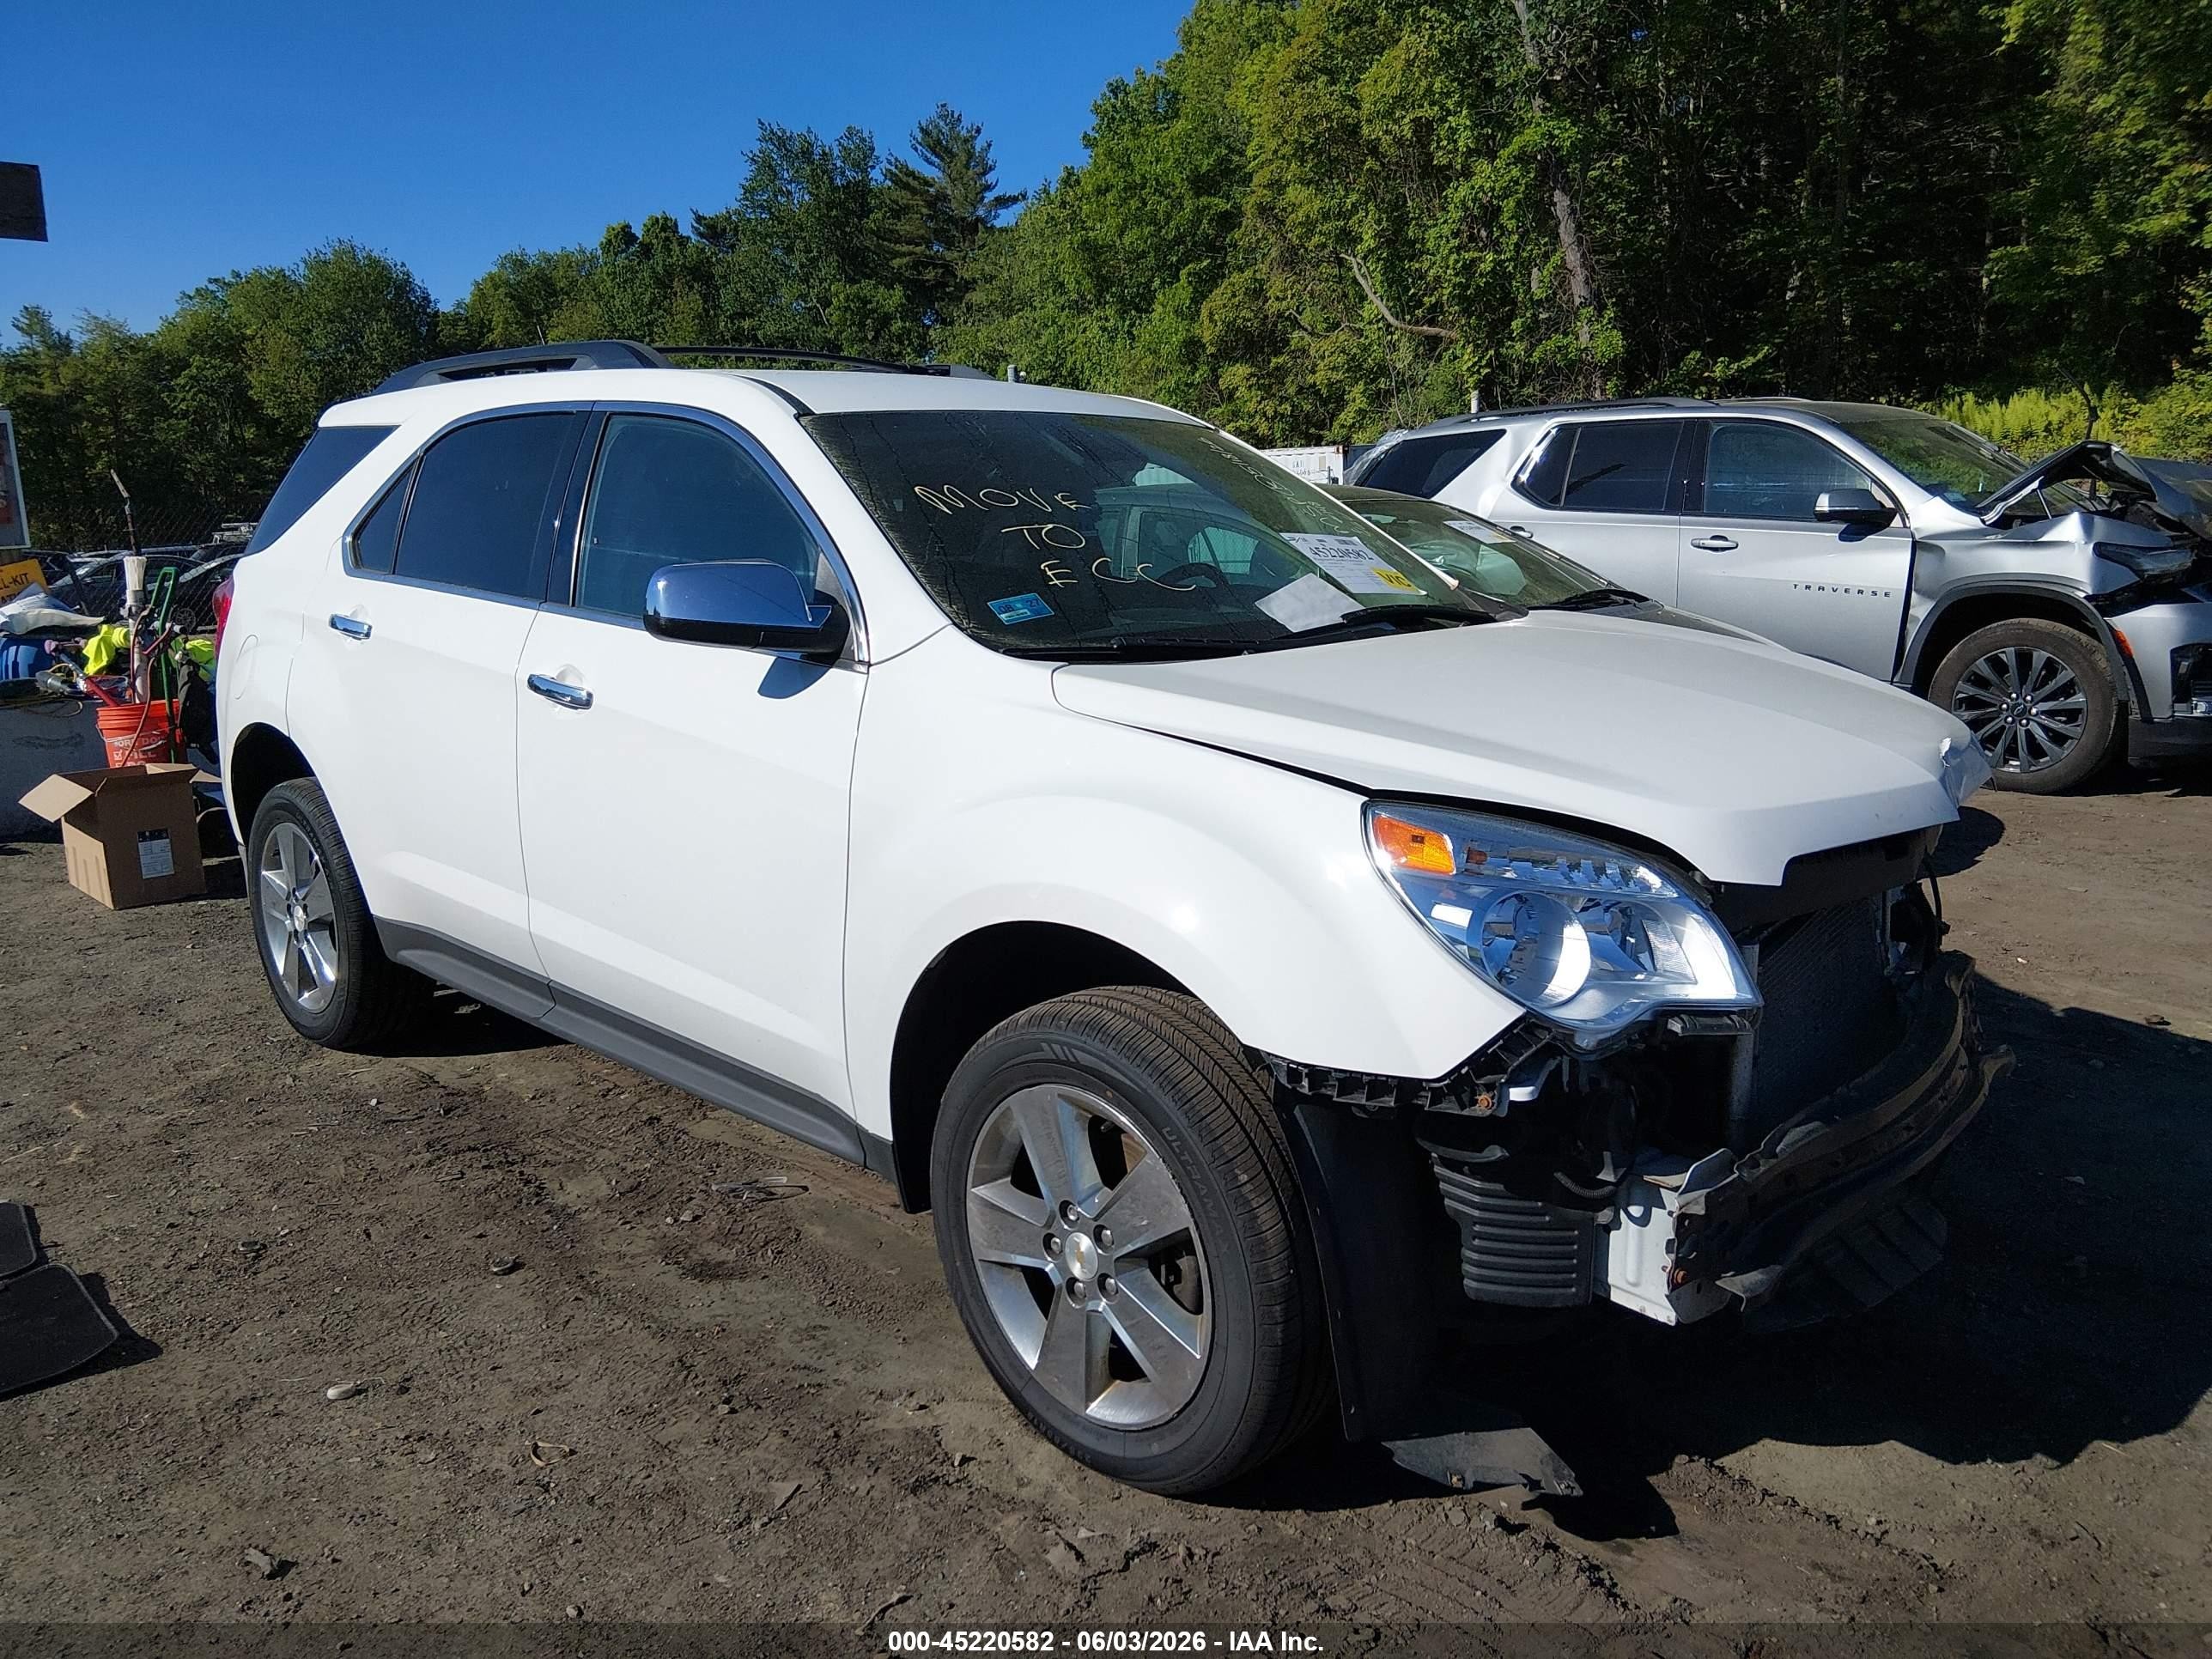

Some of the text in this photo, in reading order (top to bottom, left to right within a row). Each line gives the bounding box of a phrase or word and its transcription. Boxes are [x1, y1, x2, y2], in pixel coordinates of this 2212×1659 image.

[914, 484, 1091, 514] MOVE
[1000, 523, 1085, 550] TO
[1040, 557, 1196, 591] ECC
[1376, 571, 1413, 588] VIC
[1792, 583, 1892, 599] TRAVERSE
